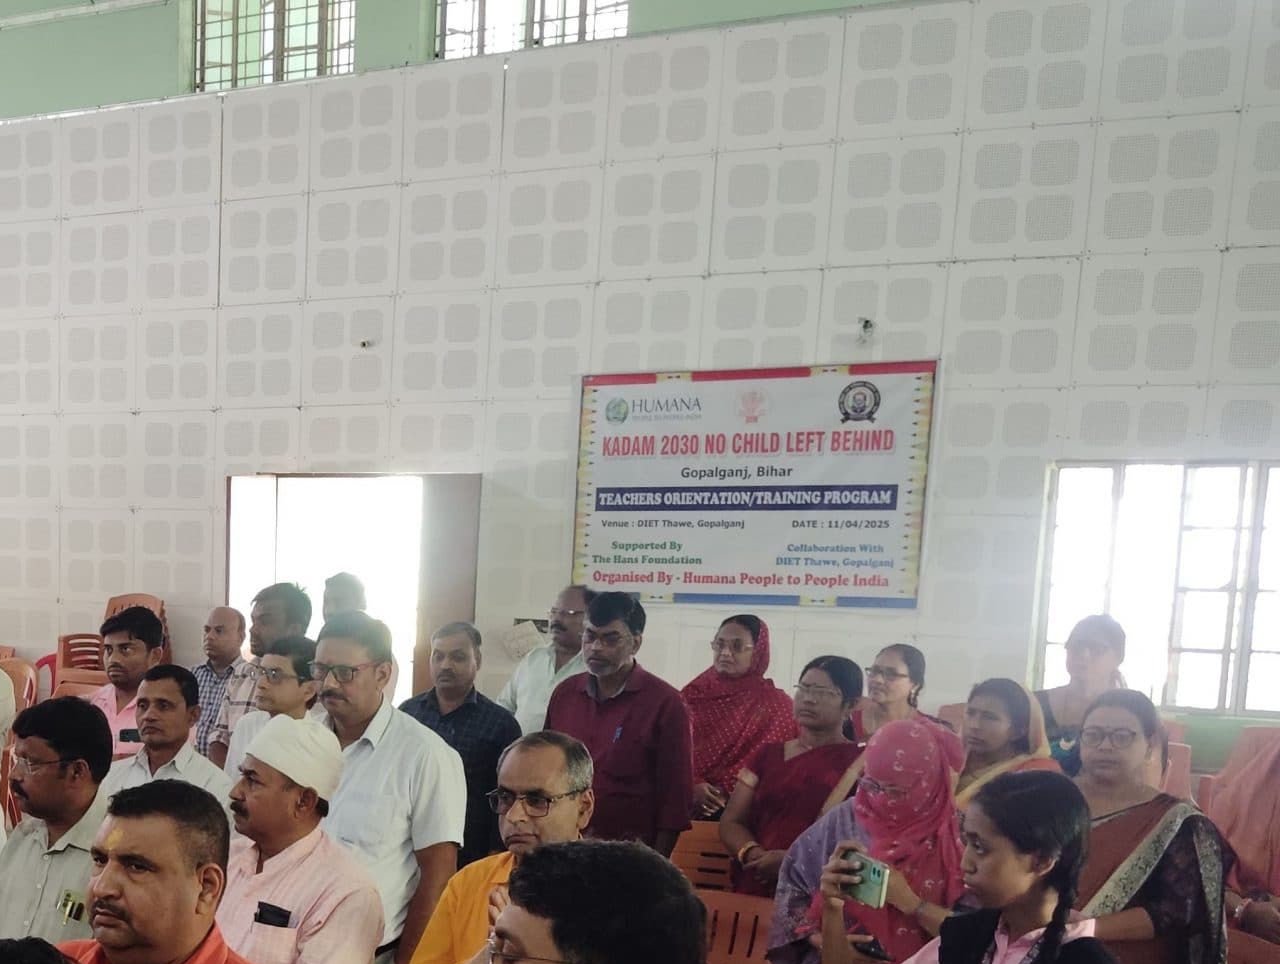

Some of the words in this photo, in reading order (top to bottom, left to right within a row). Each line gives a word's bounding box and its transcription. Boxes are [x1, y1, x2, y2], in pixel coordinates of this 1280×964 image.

[632, 398, 702, 413] HUMANA
[602, 435, 655, 456] KADAM
[660, 434, 699, 455] 2030
[704, 433, 726, 454] NO
[732, 431, 780, 454] CHILD
[786, 431, 825, 453] LEFT
[830, 430, 894, 452] BEHIND
[681, 467, 752, 480] Gopalganj,
[757, 466, 793, 477] Bihar
[599, 493, 662, 506] TEACHERS
[663, 492, 821, 506] ORIENTATION/TRAINING
[823, 490, 892, 505] PROGRAM
[601, 520, 629, 528] Venue
[637, 520, 659, 528] DIET
[662, 520, 695, 529] Thawe,
[697, 520, 745, 530] Gopalganj
[792, 520, 818, 529] DATE
[827, 520, 890, 530] 11/04/2025
[611, 541, 667, 552] Supported
[669, 541, 683, 552] By
[787, 544, 856, 553] Collaboration
[859, 544, 885, 553] With
[592, 555, 611, 564] The
[613, 555, 639, 564] Hans
[641, 555, 702, 565] Foundation
[776, 557, 801, 566] DIET
[804, 557, 840, 567] Thawe,
[842, 557, 894, 569] Gopalganj
[593, 570, 654, 585] Organised
[657, 571, 674, 586] By
[683, 571, 737, 584] Humana
[740, 572, 783, 587] People
[787, 574, 800, 586] to
[804, 573, 849, 588] People
[853, 573, 889, 587] India
